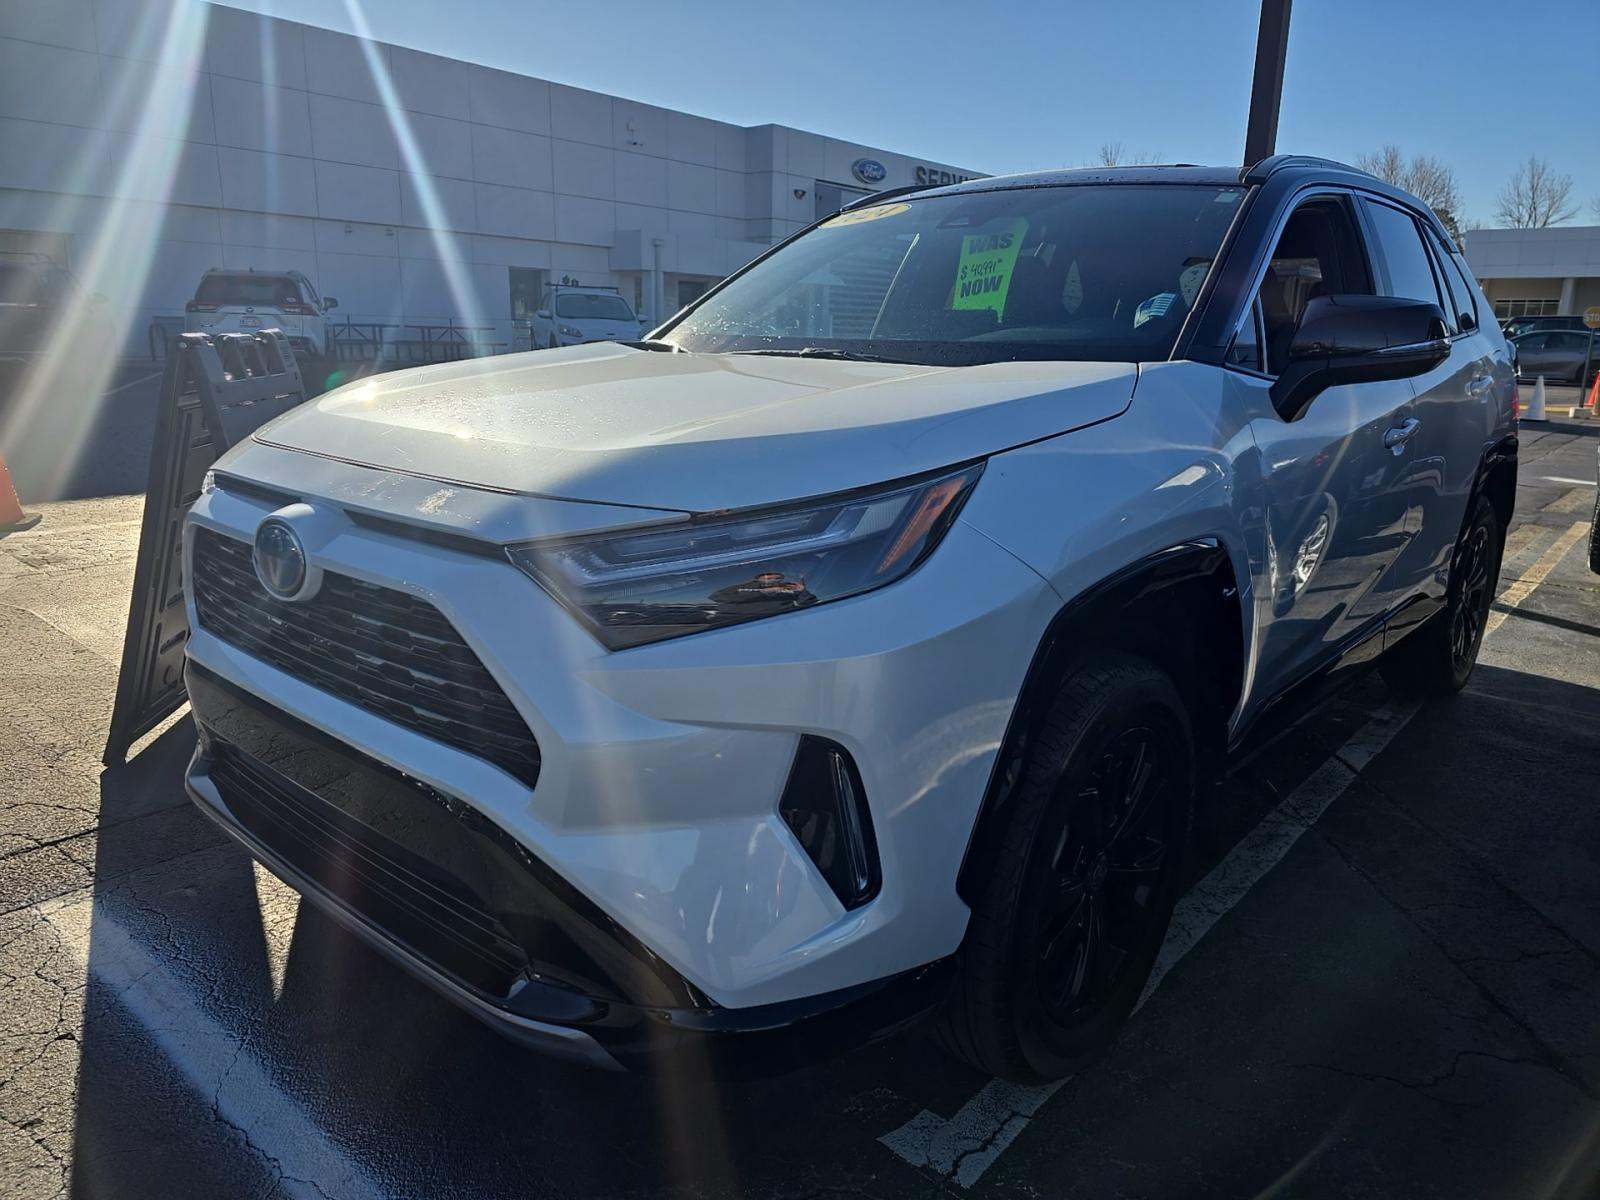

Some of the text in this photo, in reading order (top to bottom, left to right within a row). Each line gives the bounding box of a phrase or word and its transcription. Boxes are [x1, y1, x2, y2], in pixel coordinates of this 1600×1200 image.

[915, 165, 970, 186] SERV
[968, 232, 1015, 255] WAS
[960, 274, 1004, 298] NOW
